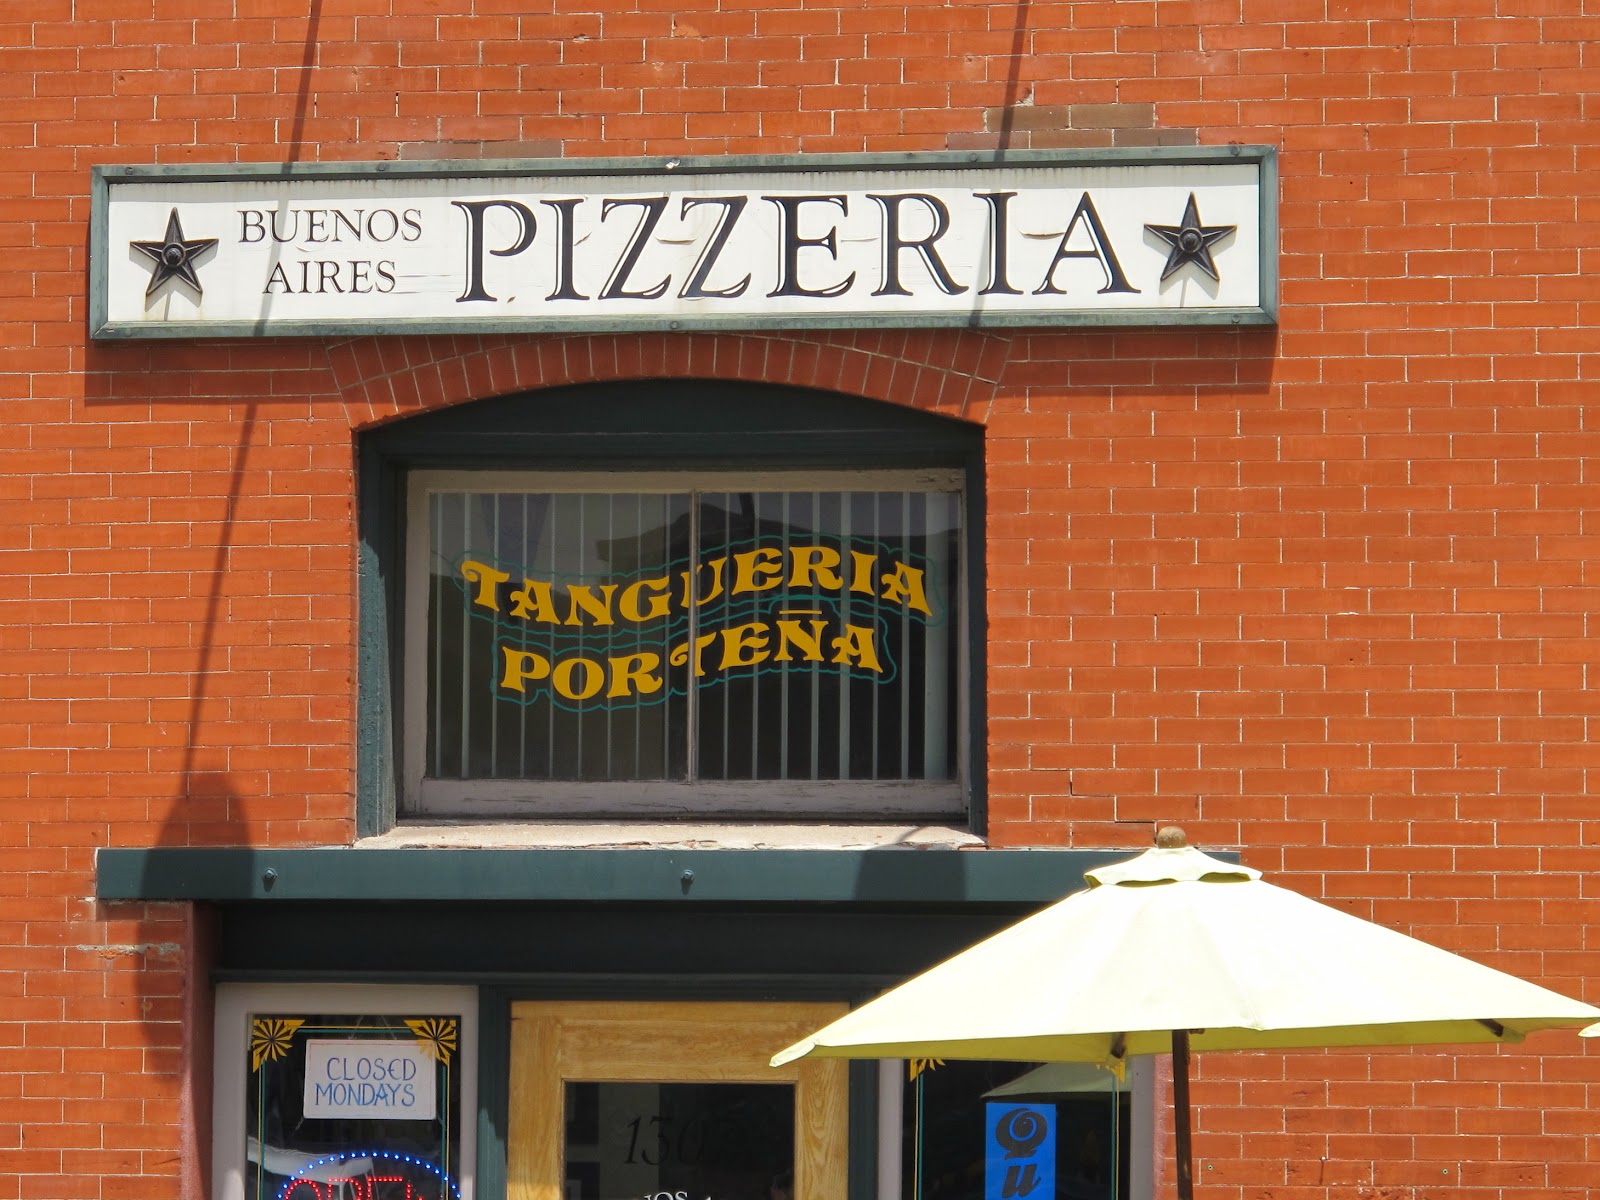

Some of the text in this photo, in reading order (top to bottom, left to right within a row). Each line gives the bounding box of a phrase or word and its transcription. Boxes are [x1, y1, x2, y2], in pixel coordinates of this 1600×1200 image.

[238, 208, 422, 244] BUENOS
[450, 191, 1141, 302] PIZZERIA
[262, 260, 397, 294] AIRES
[460, 545, 933, 627] TANGUERIA
[326, 1057, 417, 1081] CLOSED
[314, 1082, 416, 1107] MONDAYS
